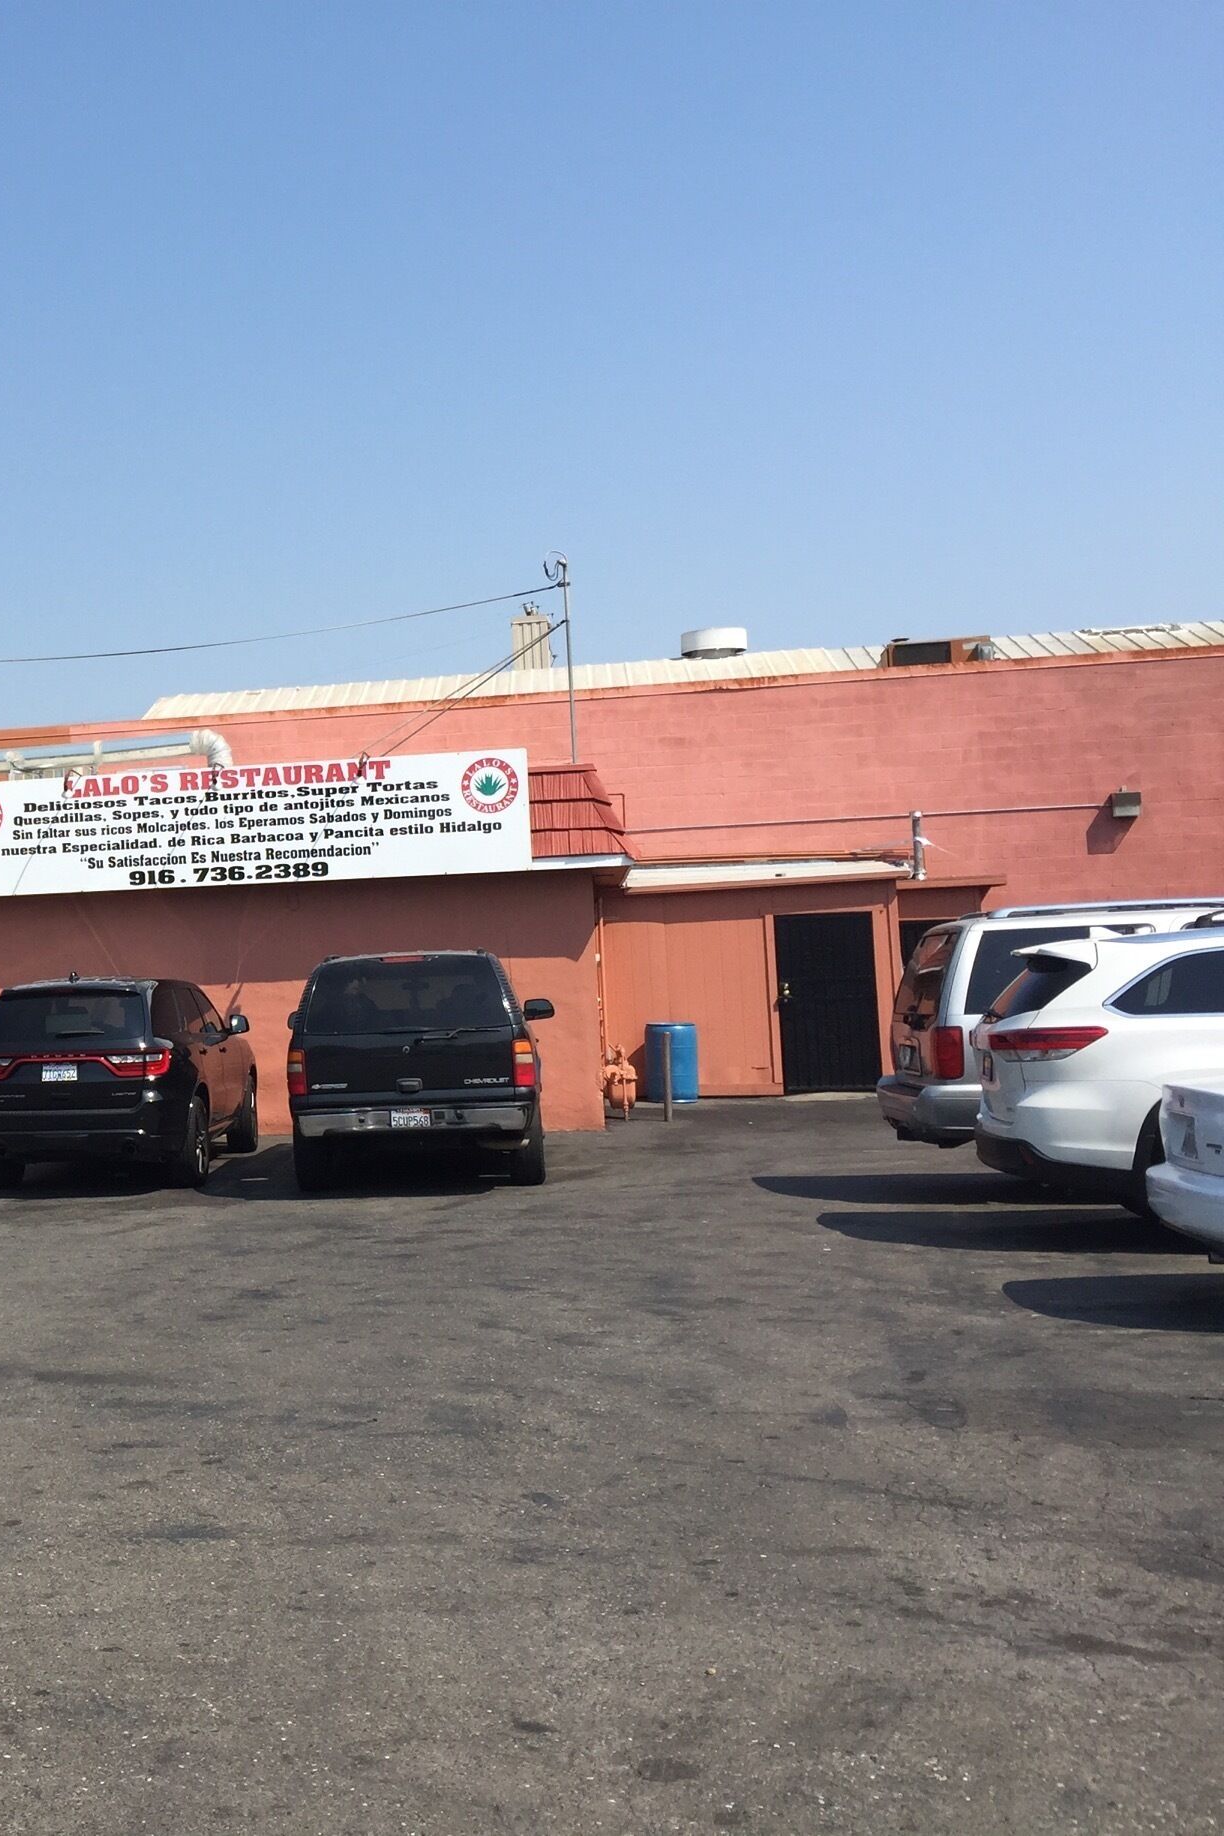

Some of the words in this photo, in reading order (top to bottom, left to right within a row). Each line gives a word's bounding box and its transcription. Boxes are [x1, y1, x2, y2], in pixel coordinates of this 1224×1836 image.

[23, 799, 127, 813] Deliciosos
[366, 779, 438, 795] Tortas
[66, 773, 169, 799] LALO'S
[179, 760, 390, 791] RESTAURANT
[170, 808, 180, 820] y
[184, 804, 218, 817] todo
[223, 802, 254, 816] tipo
[259, 800, 278, 813] de
[283, 797, 355, 812] antojitos
[360, 792, 450, 807] Mexicanos
[1, 843, 57, 856] nuestra
[167, 835, 186, 848] de
[191, 833, 225, 846] Rica
[230, 831, 304, 844] Barbacoa
[309, 830, 319, 843] y
[322, 825, 384, 840] Pancita
[389, 822, 434, 836] estilo
[439, 819, 502, 834] Hidalgo
[12, 828, 33, 841] Sin
[37, 826, 71, 839] faltar
[74, 826, 97, 837] sus
[101, 823, 133, 836] ricos
[215, 817, 235, 830] los
[238, 815, 305, 831] Eperamos
[309, 811, 367, 824] Sabados
[370, 811, 380, 824] y
[383, 806, 453, 821] Domingos
[107, 852, 187, 869] Satisfaccion
[190, 850, 207, 864] Es
[211, 849, 262, 863] Nuestra
